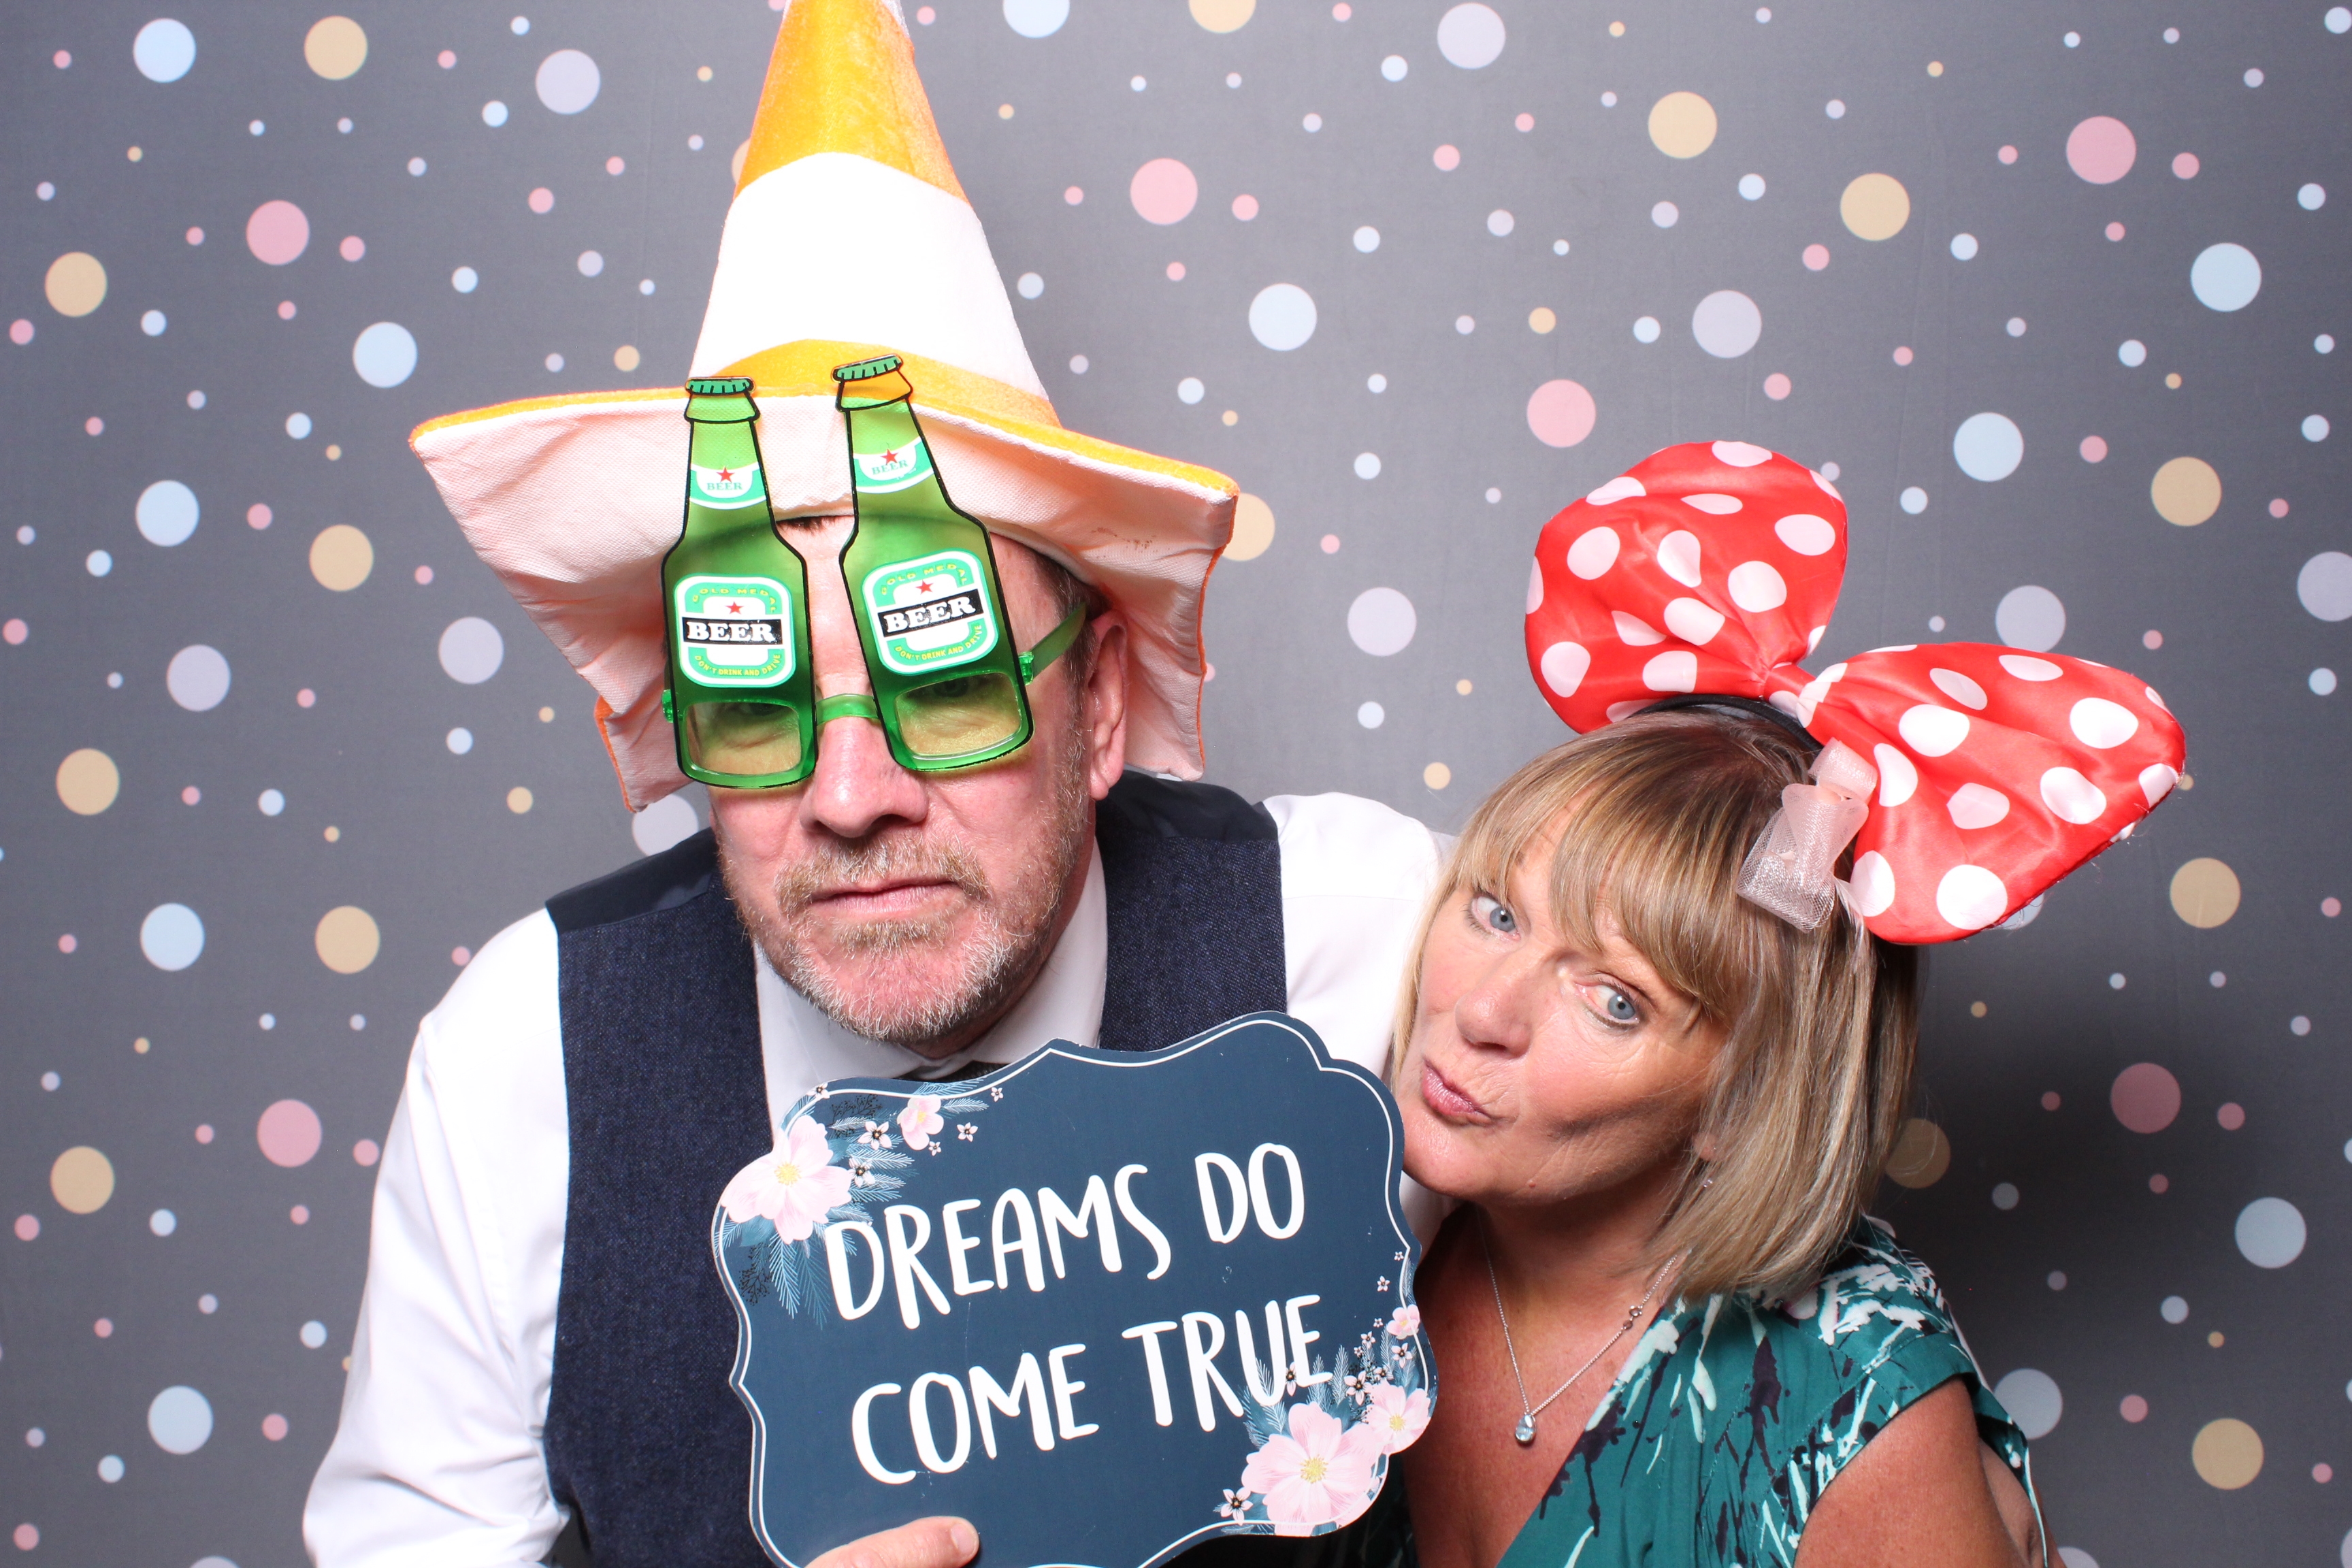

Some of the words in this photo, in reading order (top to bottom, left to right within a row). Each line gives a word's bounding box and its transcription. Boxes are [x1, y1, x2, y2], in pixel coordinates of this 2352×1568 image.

[871, 459, 909, 475] BEER
[706, 482, 743, 491] BEER
[881, 572, 917, 595] GOLD
[924, 564, 968, 584] MEDAL
[692, 588, 730, 602] GOLD
[736, 587, 777, 612] MEDAL
[883, 597, 976, 633] BEER
[686, 621, 775, 642] BEER
[894, 646, 919, 661] DON'T
[921, 650, 946, 661] DRINK
[948, 646, 964, 655] AND
[965, 624, 982, 649] DRIVE
[694, 655, 717, 674] DON'T
[762, 654, 781, 674] DRIVE
[825, 1164, 1171, 1329] DREAMS
[1194, 1143, 1305, 1243] DO
[851, 1343, 1099, 1485] COME
[1122, 1294, 1333, 1433] TRUE
